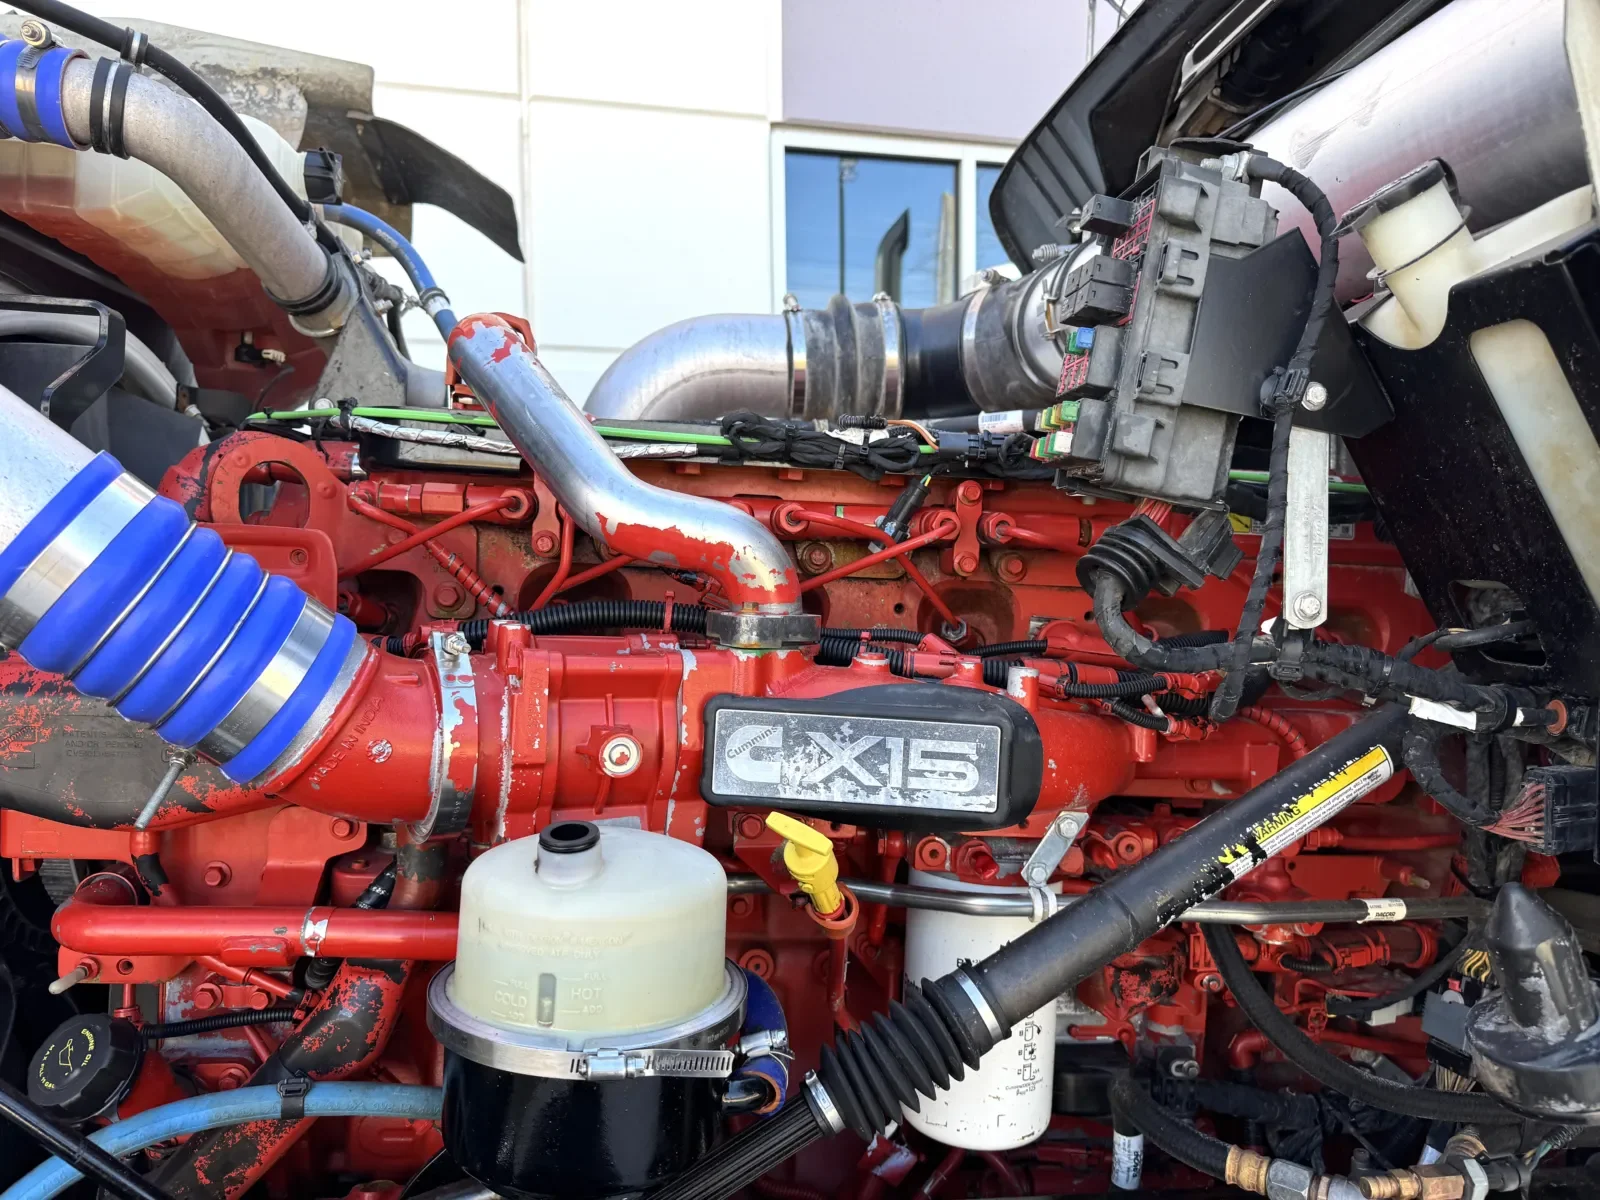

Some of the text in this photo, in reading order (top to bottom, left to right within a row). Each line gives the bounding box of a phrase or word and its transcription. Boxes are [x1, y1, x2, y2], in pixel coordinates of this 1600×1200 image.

[308, 697, 385, 784] MADE IN INDIA
[727, 727, 778, 759] Cummins
[800, 731, 979, 792] X15
[494, 990, 528, 1008] COLD
[571, 987, 602, 1000] HOT
[582, 1005, 603, 1015] ADD
[43, 1044, 55, 1061] MAX
[81, 1028, 95, 1067] ENGINE OIL
[45, 1081, 55, 1089] GAL
